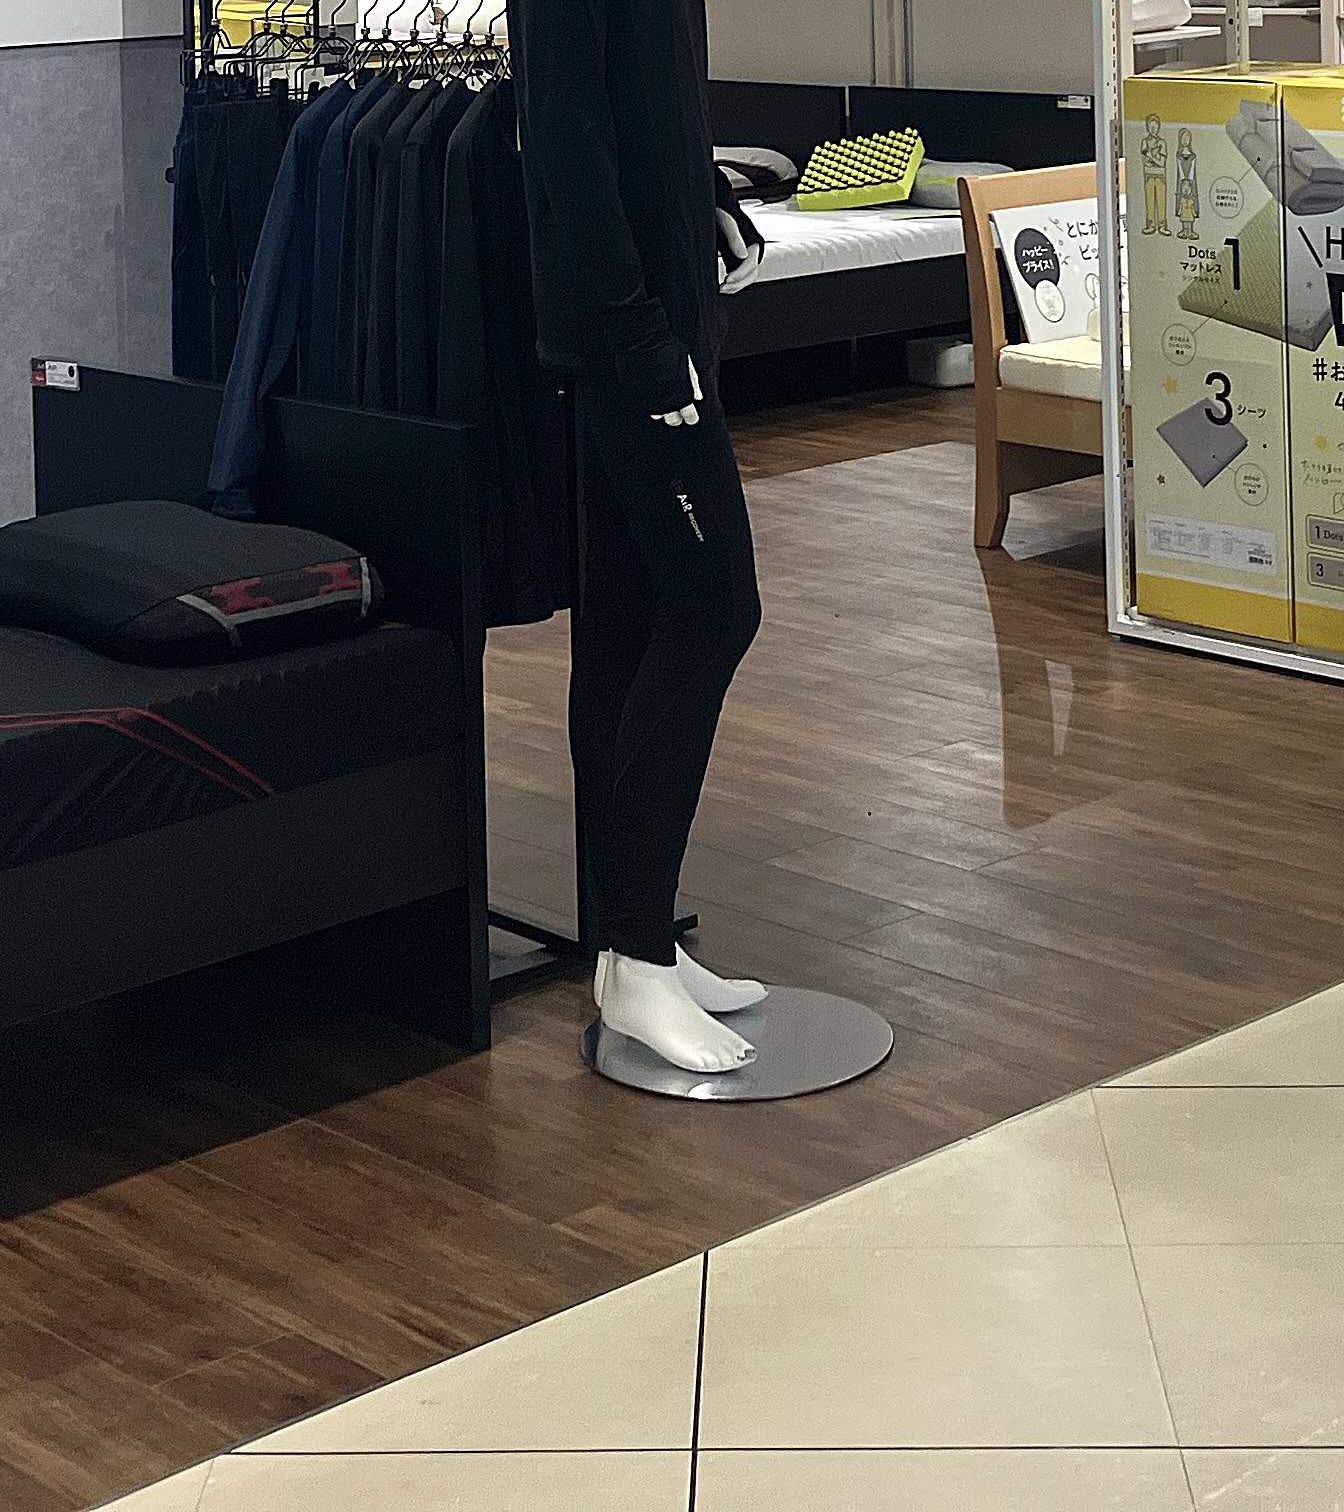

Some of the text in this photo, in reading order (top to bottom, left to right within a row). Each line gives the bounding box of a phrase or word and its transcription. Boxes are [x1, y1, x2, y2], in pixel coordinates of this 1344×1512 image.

[1188, 246, 1216, 259] Dots
[1179, 261, 1222, 273] マットレス
[1224, 238, 1241, 290] 1
[1205, 372, 1267, 426] 3 シーツ
[1314, 526, 1320, 539] 1
[1316, 563, 1324, 577] 3
